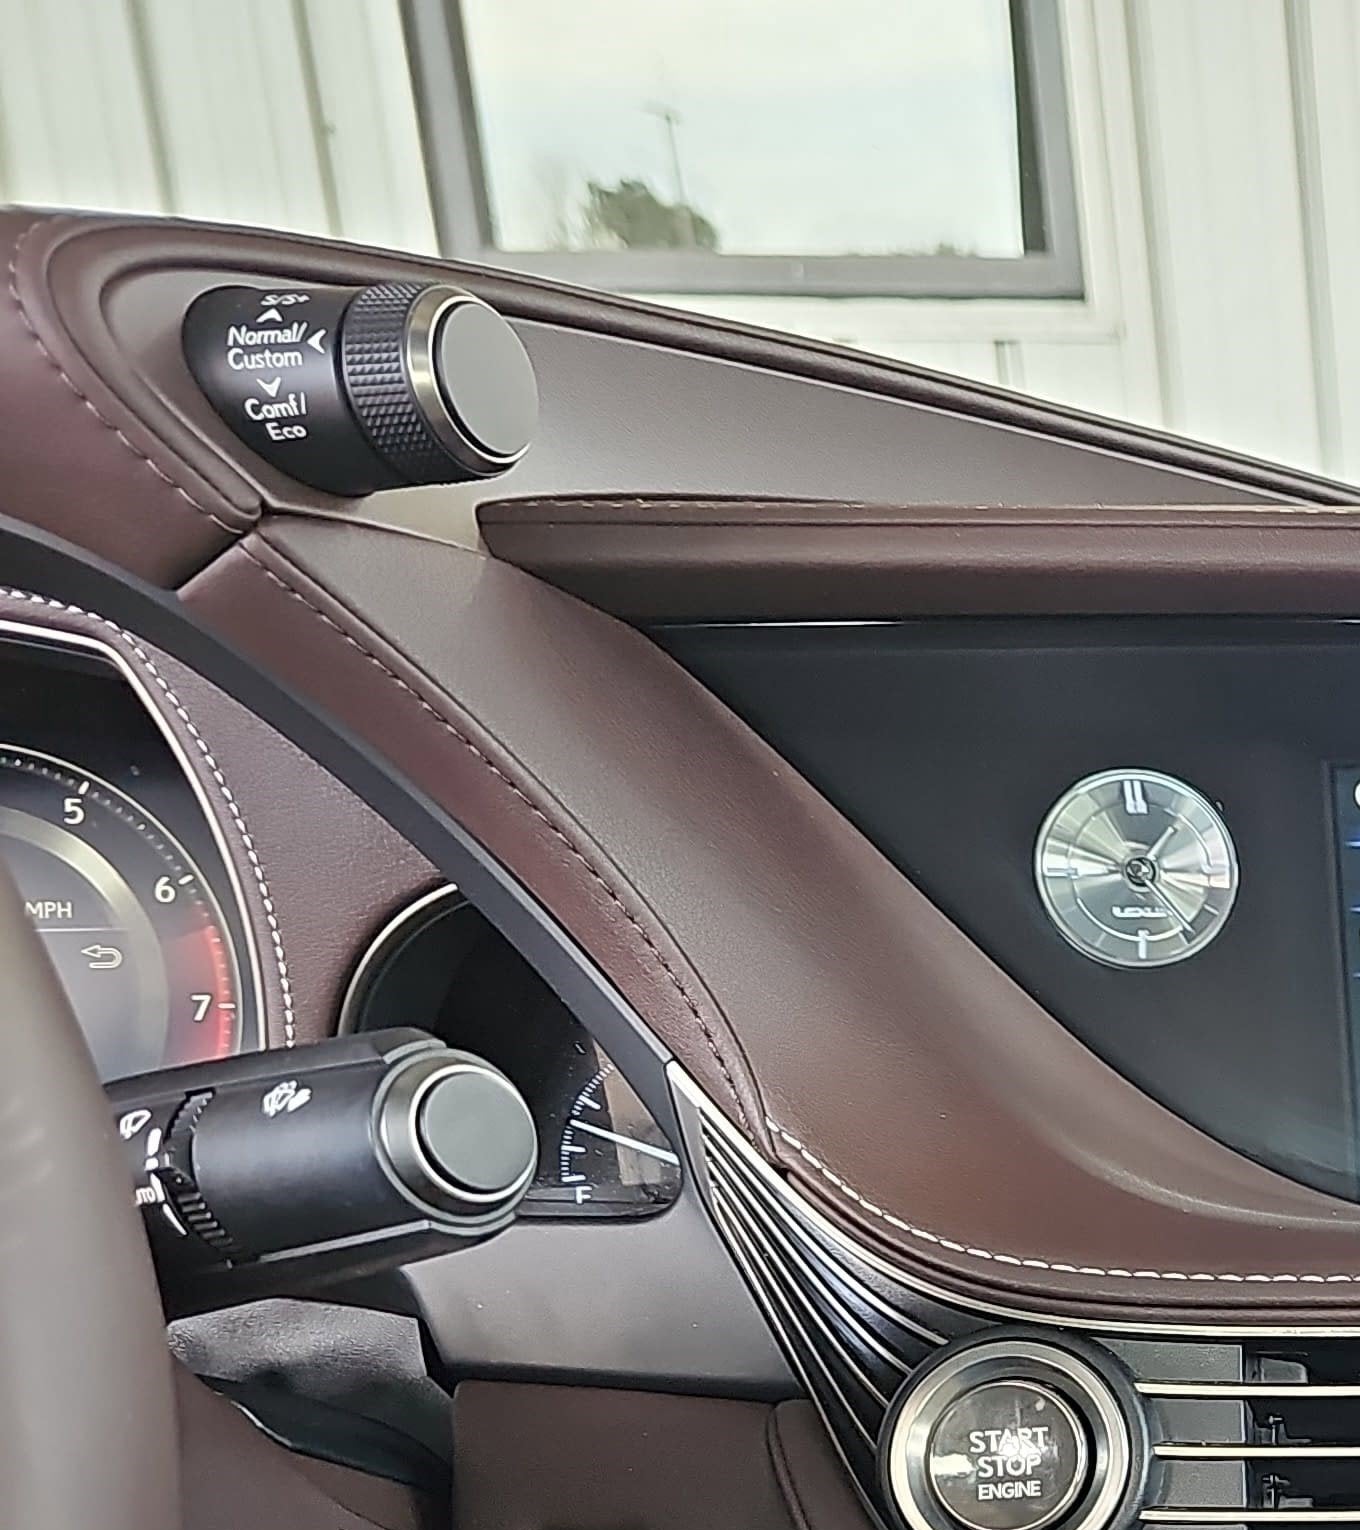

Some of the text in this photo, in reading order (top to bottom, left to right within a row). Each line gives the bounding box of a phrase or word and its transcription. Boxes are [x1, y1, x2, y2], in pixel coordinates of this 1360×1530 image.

[227, 322, 308, 346] Normal/
[227, 348, 303, 370] Custom
[244, 392, 307, 420] Comf/
[265, 422, 307, 441] Eco
[63, 798, 85, 825] 5
[154, 876, 176, 903] 6
[24, 901, 73, 919] MPH
[191, 994, 212, 1021] 7
[575, 1185, 593, 1204] F
[969, 1426, 1049, 1454] START
[977, 1454, 1042, 1478] STOP
[977, 1480, 1042, 1501] ENGINE
